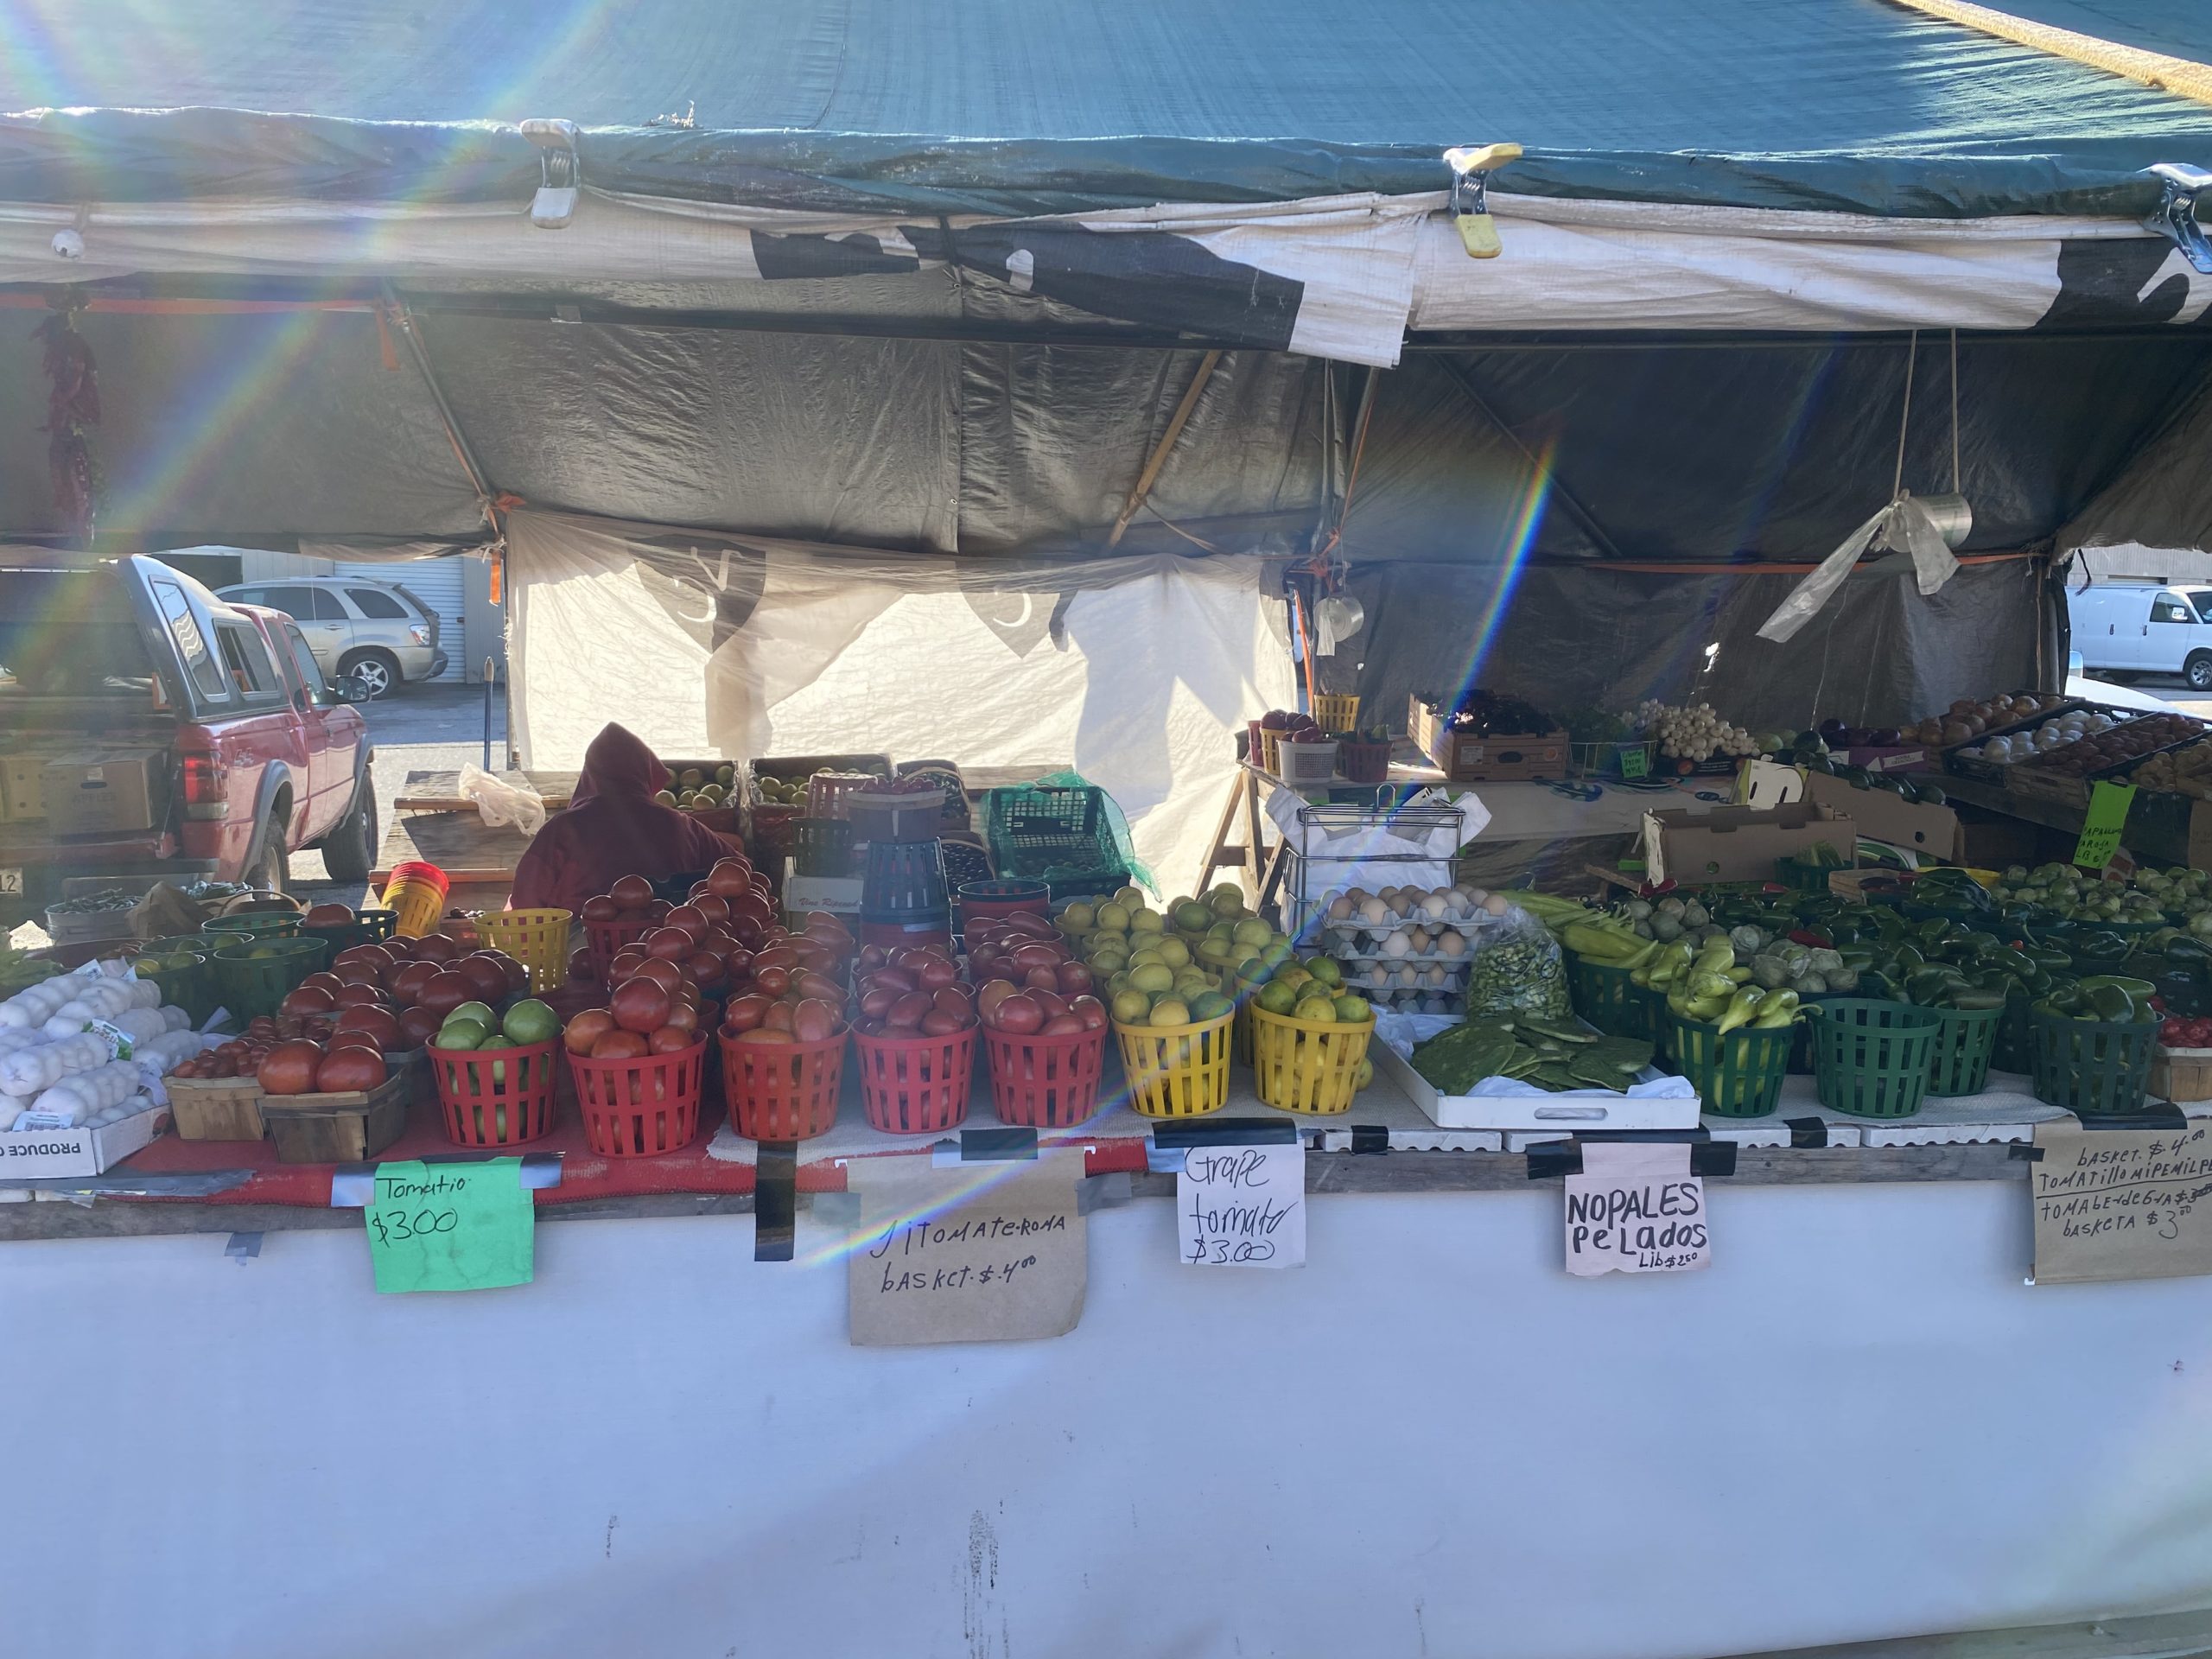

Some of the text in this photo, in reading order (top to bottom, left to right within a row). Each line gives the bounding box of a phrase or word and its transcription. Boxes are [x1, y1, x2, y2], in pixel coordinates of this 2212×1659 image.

[9, 1142, 81, 1156] PRODUCE
[1568, 1183, 1700, 1230] NOPALES
[372, 1208, 458, 1249] $3.00
[1573, 1221, 1707, 1255] PeLados
[1185, 1234, 1275, 1264] $3.00
